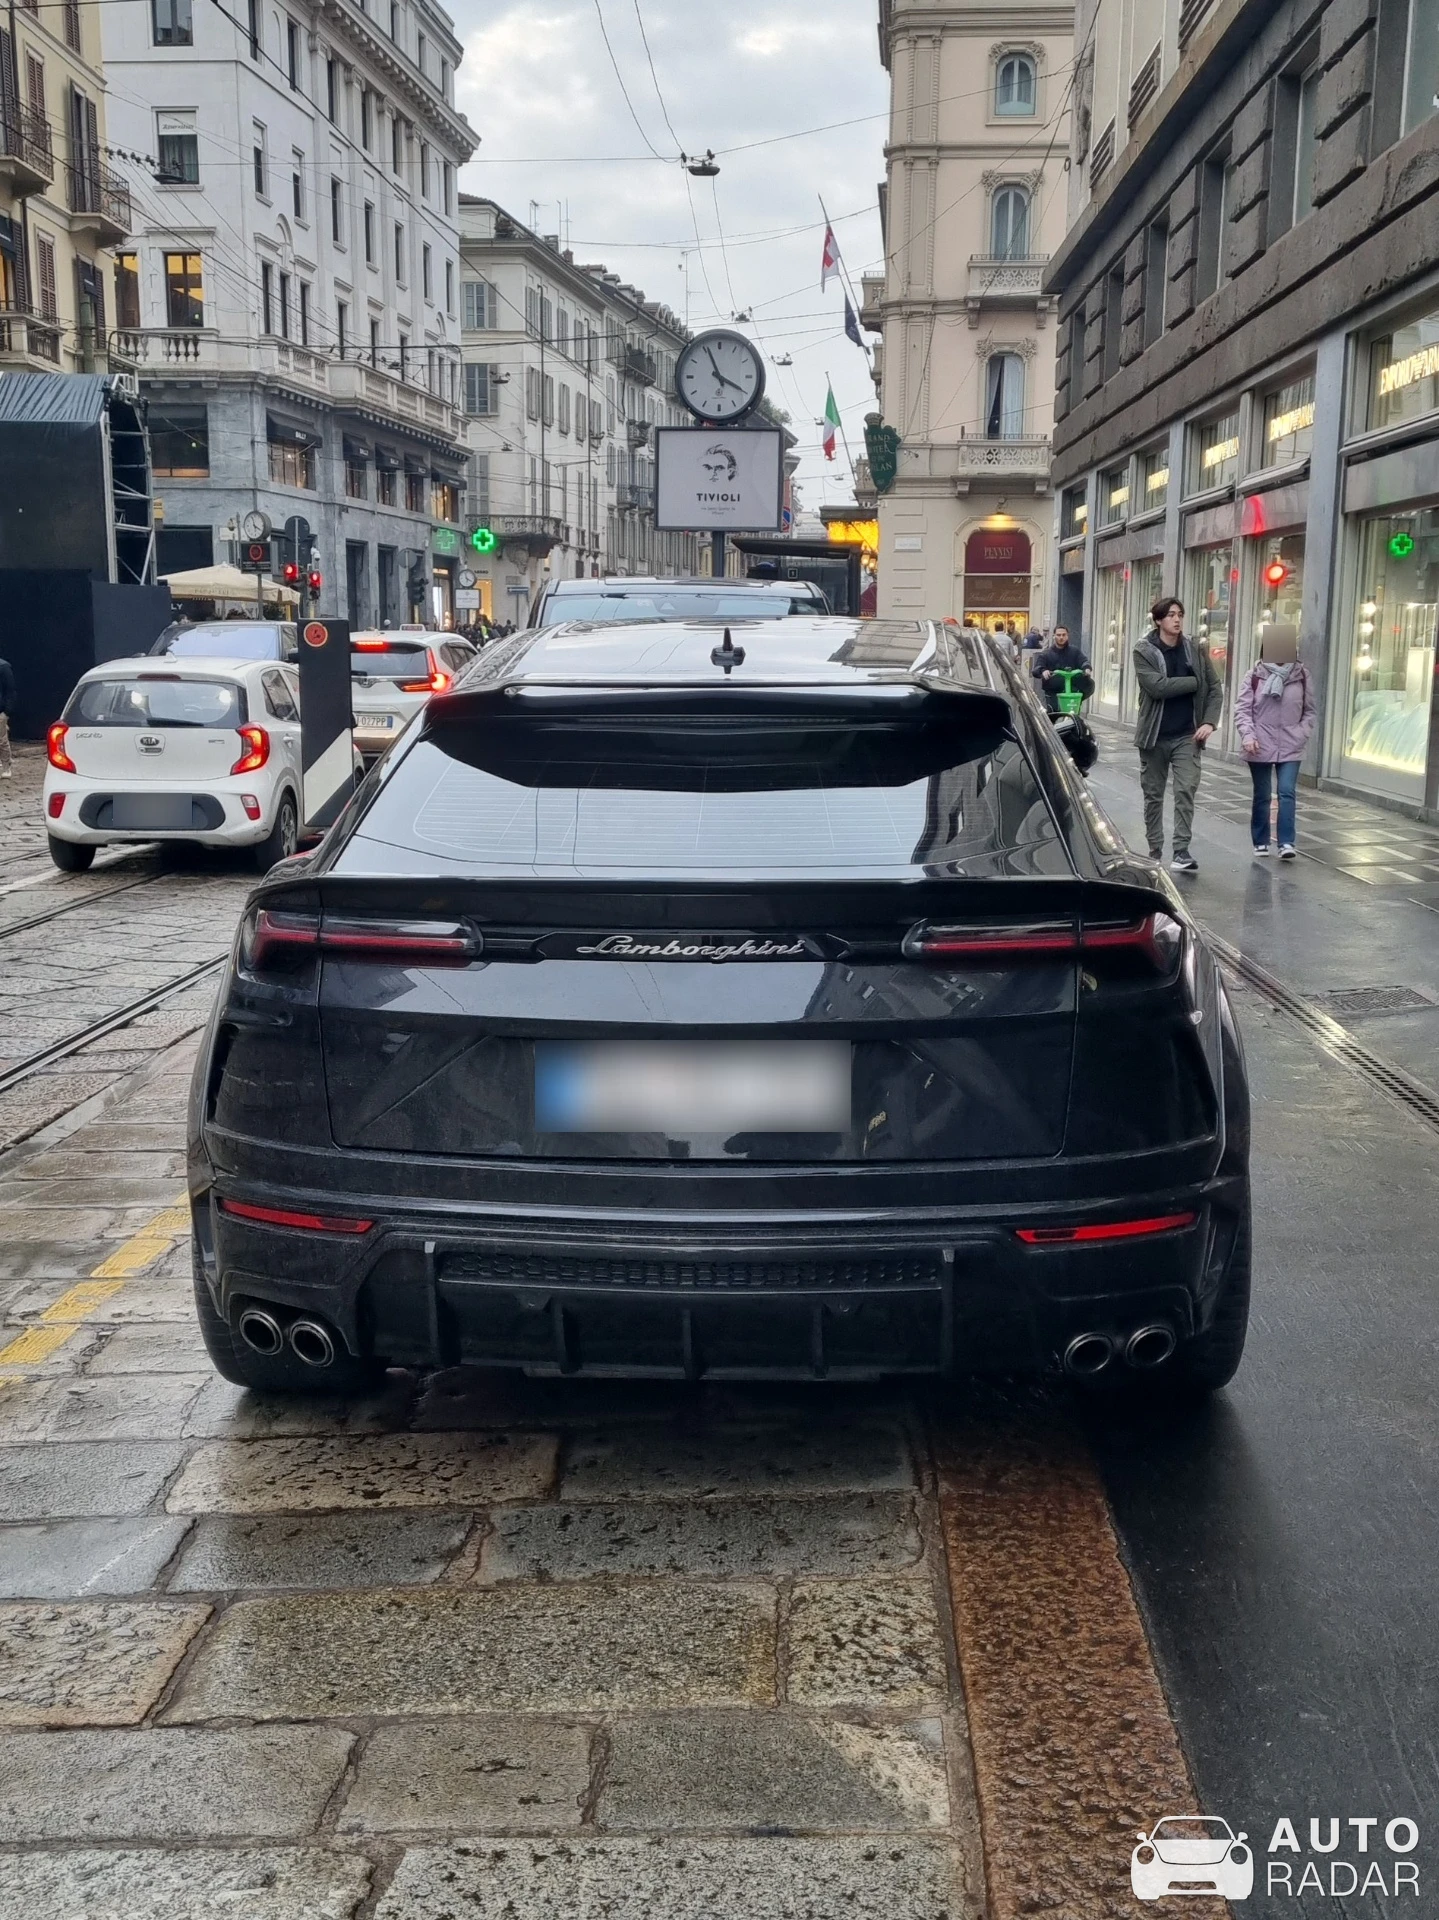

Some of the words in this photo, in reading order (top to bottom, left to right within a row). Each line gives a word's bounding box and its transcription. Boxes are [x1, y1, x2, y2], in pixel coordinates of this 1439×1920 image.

[696, 492, 740, 502] TIVIOLI
[142, 737, 157, 745] KIA
[576, 935, 807, 960] Lamborghini
